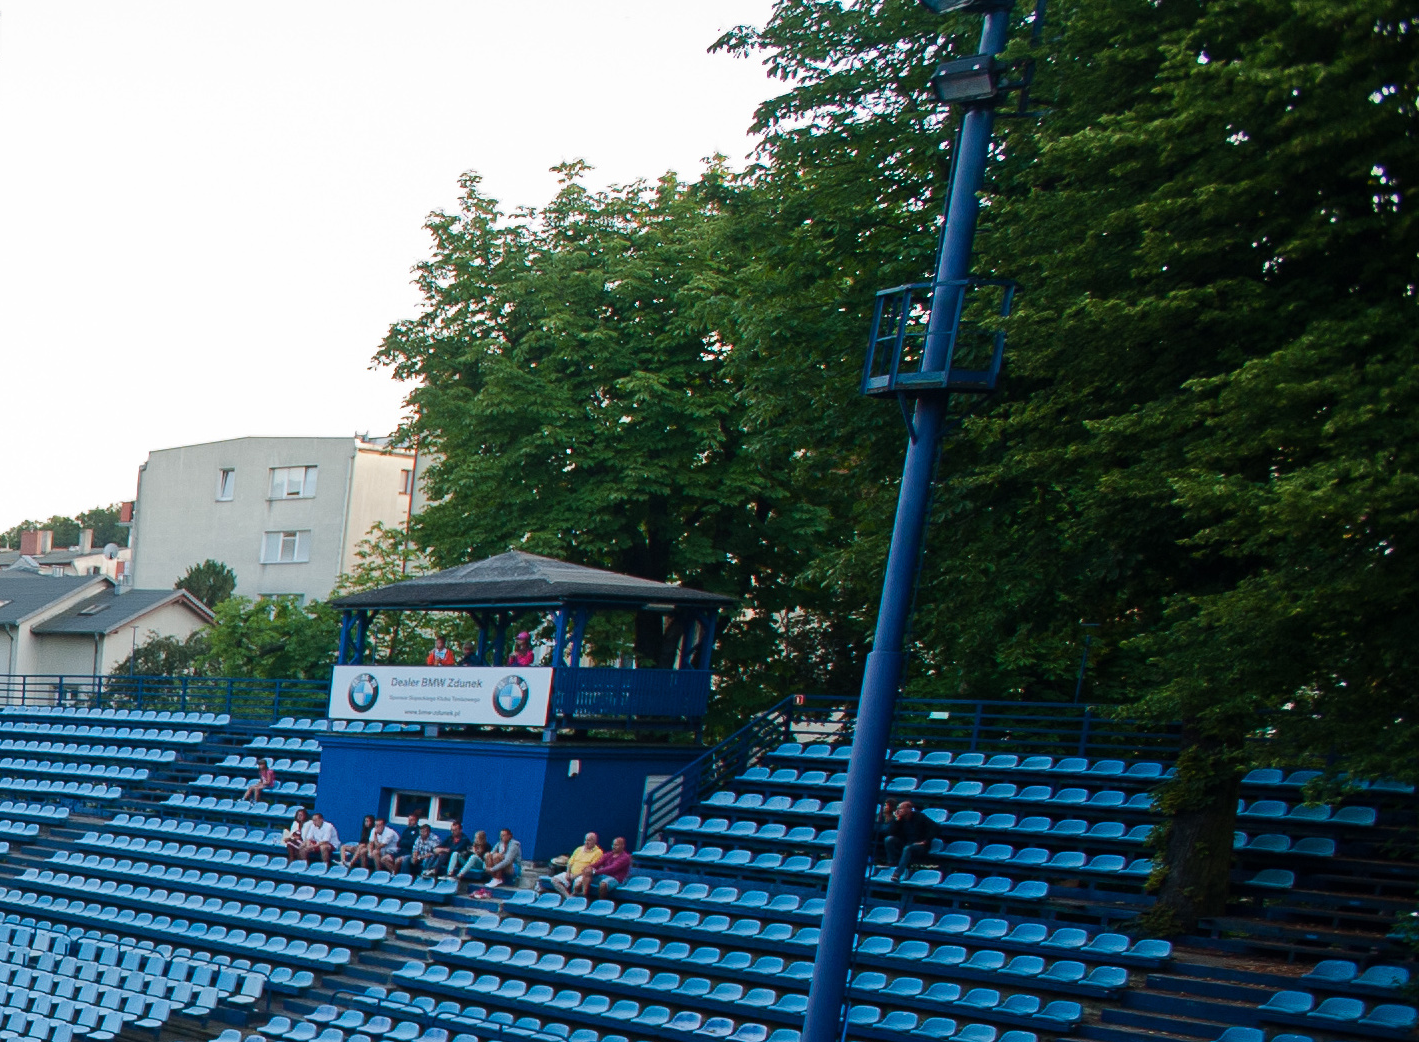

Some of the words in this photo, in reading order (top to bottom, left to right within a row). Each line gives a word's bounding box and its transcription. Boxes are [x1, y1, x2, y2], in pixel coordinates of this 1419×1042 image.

[390, 677, 420, 687] Dealer
[421, 677, 447, 688] BMW
[447, 678, 483, 689] Zdunek
